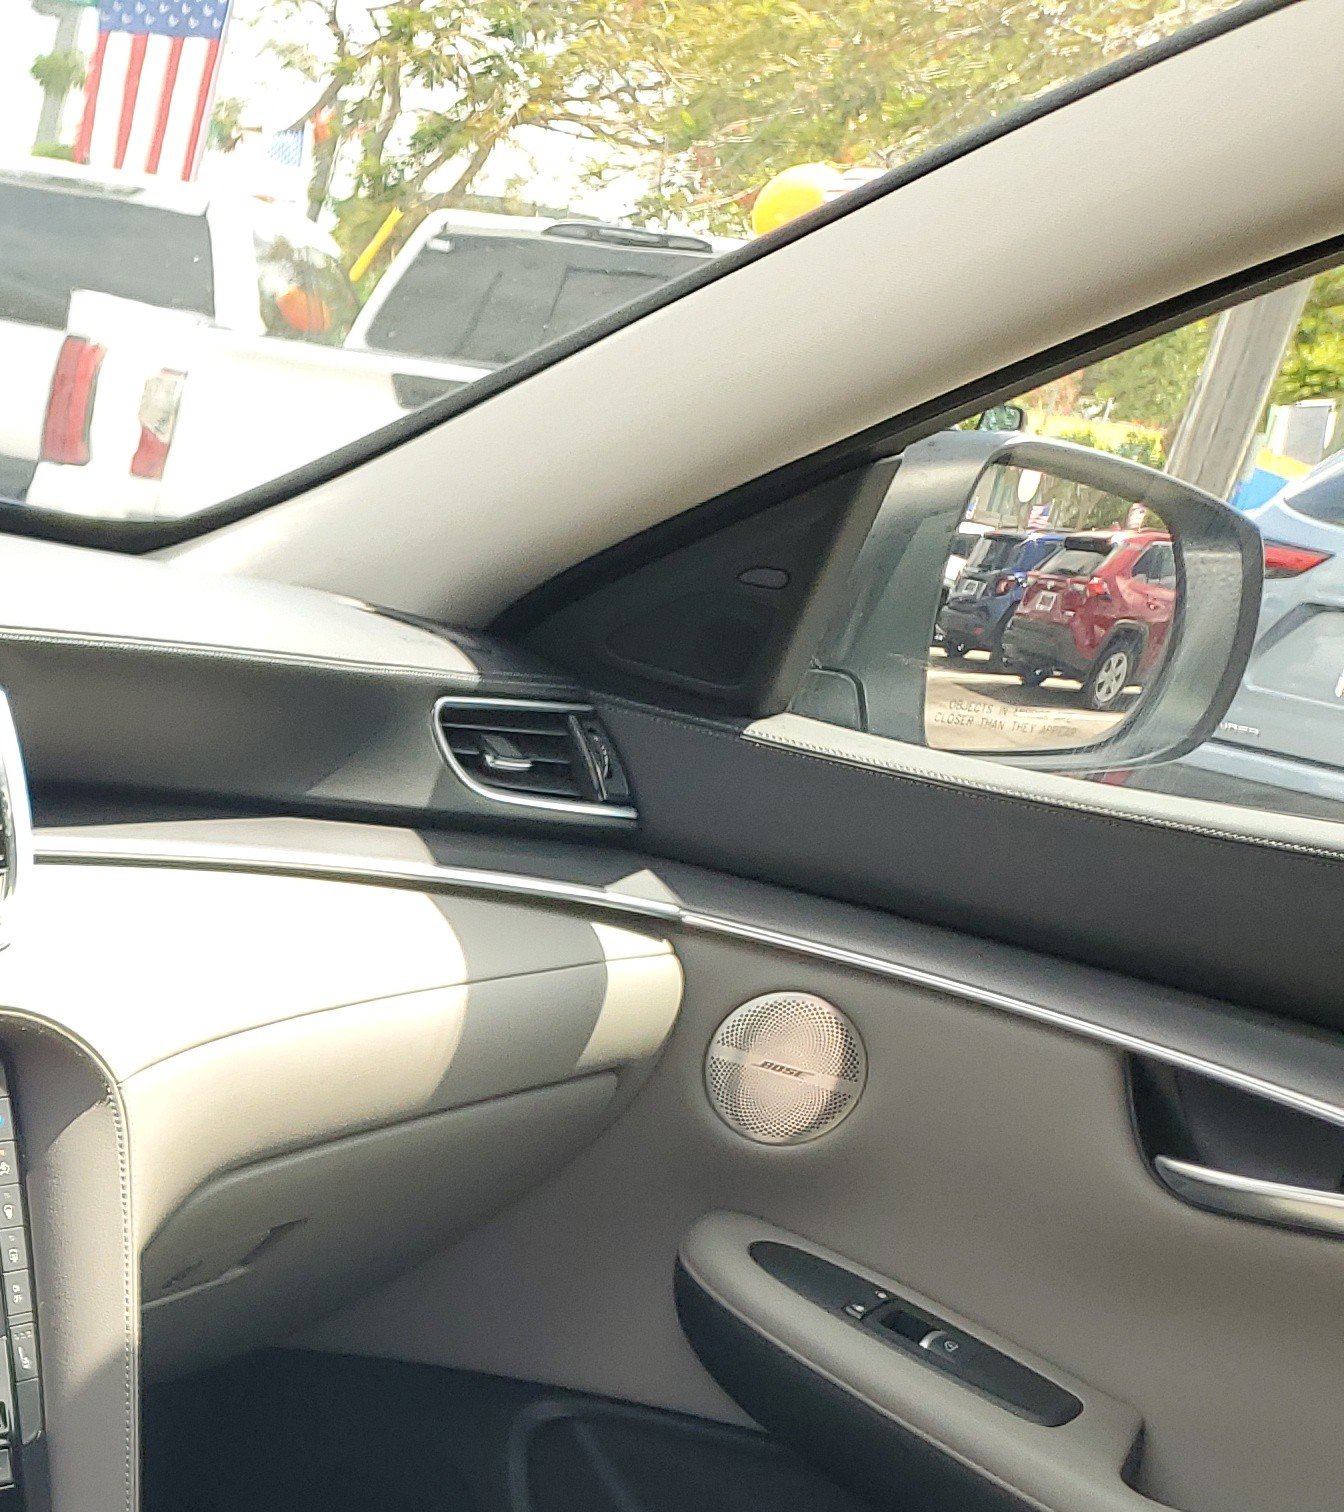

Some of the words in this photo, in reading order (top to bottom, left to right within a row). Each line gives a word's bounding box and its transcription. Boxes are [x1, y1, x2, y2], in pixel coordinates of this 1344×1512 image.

[949, 700, 993, 714] OBJECTS
[934, 712, 973, 726] CLOSER
[980, 717, 1004, 730] THAN
[1012, 721, 1035, 733] THEY
